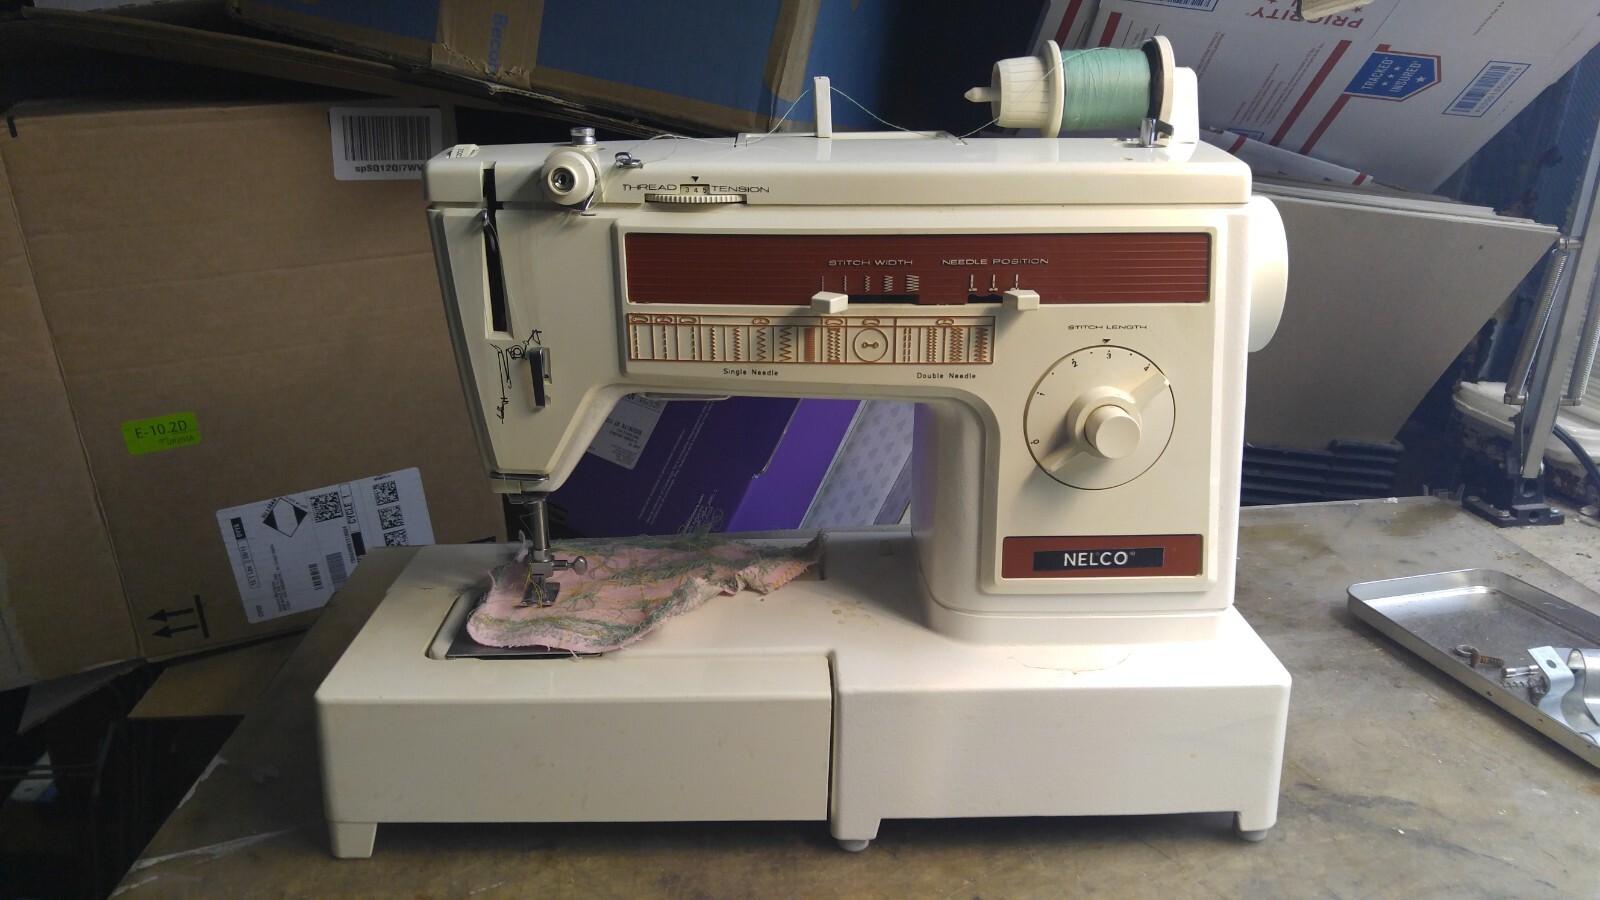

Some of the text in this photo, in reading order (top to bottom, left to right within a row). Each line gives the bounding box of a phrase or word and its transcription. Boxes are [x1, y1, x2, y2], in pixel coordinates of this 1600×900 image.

[1361, 59, 1393, 90] TRACKED
[1388, 62, 1422, 92] INSURED
[711, 185, 770, 193] TENSION
[723, 367, 779, 376] Single Needle
[1071, 360, 1078, 368] 2
[135, 420, 187, 439] E-10.2D
[343, 503, 356, 524] CYCLE
[1063, 551, 1128, 567] NELCO
